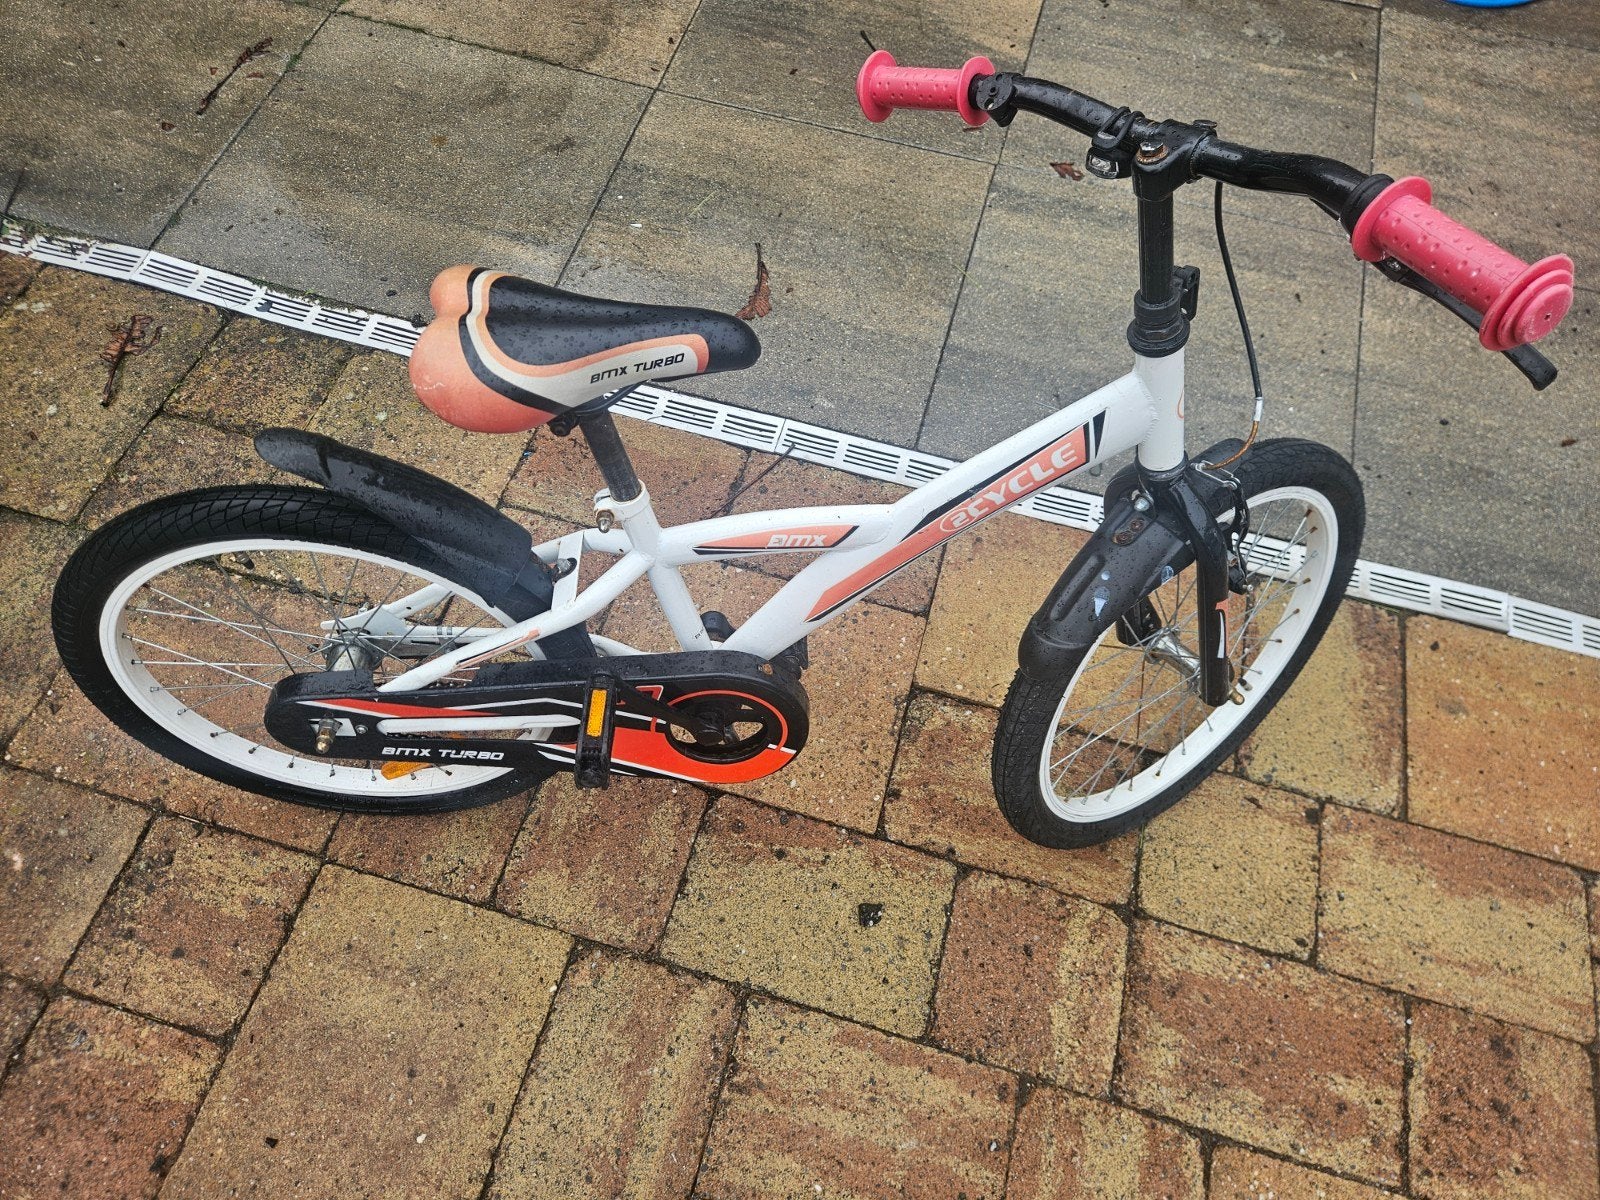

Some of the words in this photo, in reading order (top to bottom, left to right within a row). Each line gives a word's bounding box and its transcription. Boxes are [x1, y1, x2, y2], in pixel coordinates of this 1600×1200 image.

[590, 366, 627, 384] BMX
[633, 353, 685, 372] TURBO
[381, 746, 431, 757] BMX
[438, 749, 505, 760] TURBO
